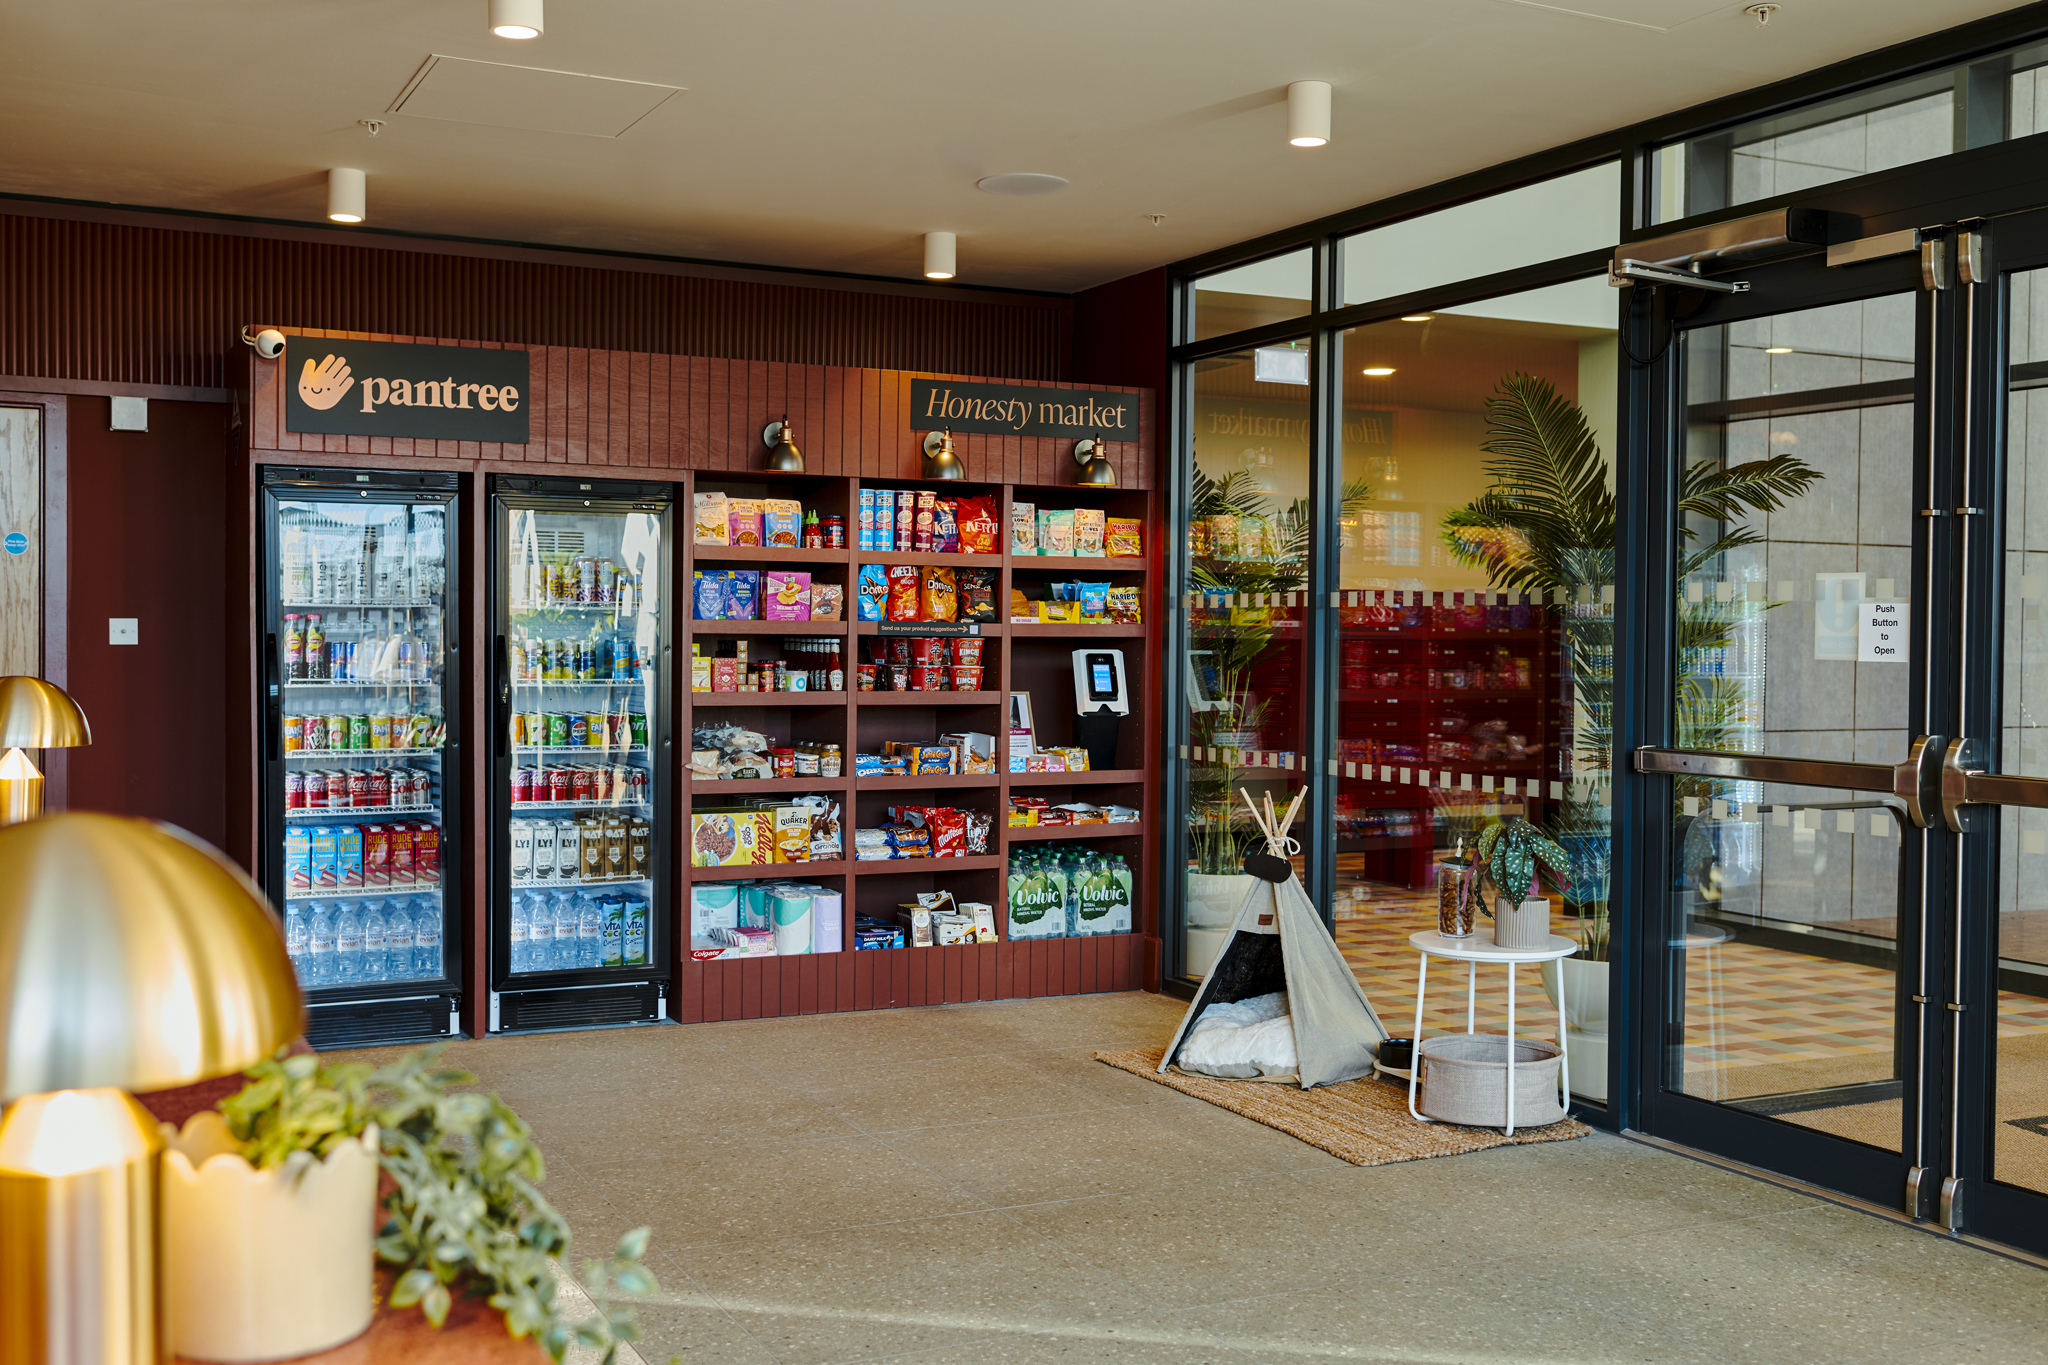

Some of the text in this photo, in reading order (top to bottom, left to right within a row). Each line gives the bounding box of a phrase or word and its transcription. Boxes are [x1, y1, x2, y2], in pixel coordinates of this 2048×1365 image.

[359, 376, 520, 413] pantree
[925, 388, 1127, 430] Honesty market
[1112, 523, 1138, 531] HARIBO
[702, 581, 719, 589] Tilda
[736, 581, 750, 589] Tilda
[927, 580, 953, 593] Doritos
[1875, 605, 1895, 613] Push
[1872, 618, 1898, 627] Button
[1880, 633, 1889, 641] to
[930, 642, 941, 660] 辛
[959, 648, 979, 656] KIMCHI
[1874, 646, 1895, 656] Open
[925, 672, 937, 689] 辛
[956, 677, 977, 685] KIMCHI
[921, 750, 949, 759] Jaffa Cakes
[858, 768, 884, 777] OREO
[920, 766, 949, 775] Jaffa Cakes
[419, 832, 437, 841] RUDE
[583, 829, 603, 839] OAT-
[605, 829, 625, 838] OAT-
[630, 828, 650, 837] OAT-
[287, 837, 307, 846] RUDE
[315, 836, 335, 845] RUDE
[340, 836, 360, 845] RUDE
[368, 835, 387, 844] RUDE
[392, 834, 411, 843] RUDE
[562, 839, 577, 847] LY!
[586, 838, 600, 847] LY!
[609, 837, 623, 846] LY!
[634, 836, 647, 844] LY!
[340, 844, 360, 852] HEALTH
[367, 843, 388, 851] HEALTH
[392, 842, 412, 850] HEALTH
[419, 841, 438, 849] HEALTH
[515, 840, 530, 848] LY!
[538, 839, 552, 848] LY!
[287, 845, 307, 854] HEALTH
[315, 845, 335, 853] HEALTH
[1017, 888, 1059, 906] Volvic
[1083, 884, 1124, 901] Volvic
[604, 921, 621, 931] VITA
[626, 920, 643, 930] VITA
[693, 950, 720, 958] Colgate
